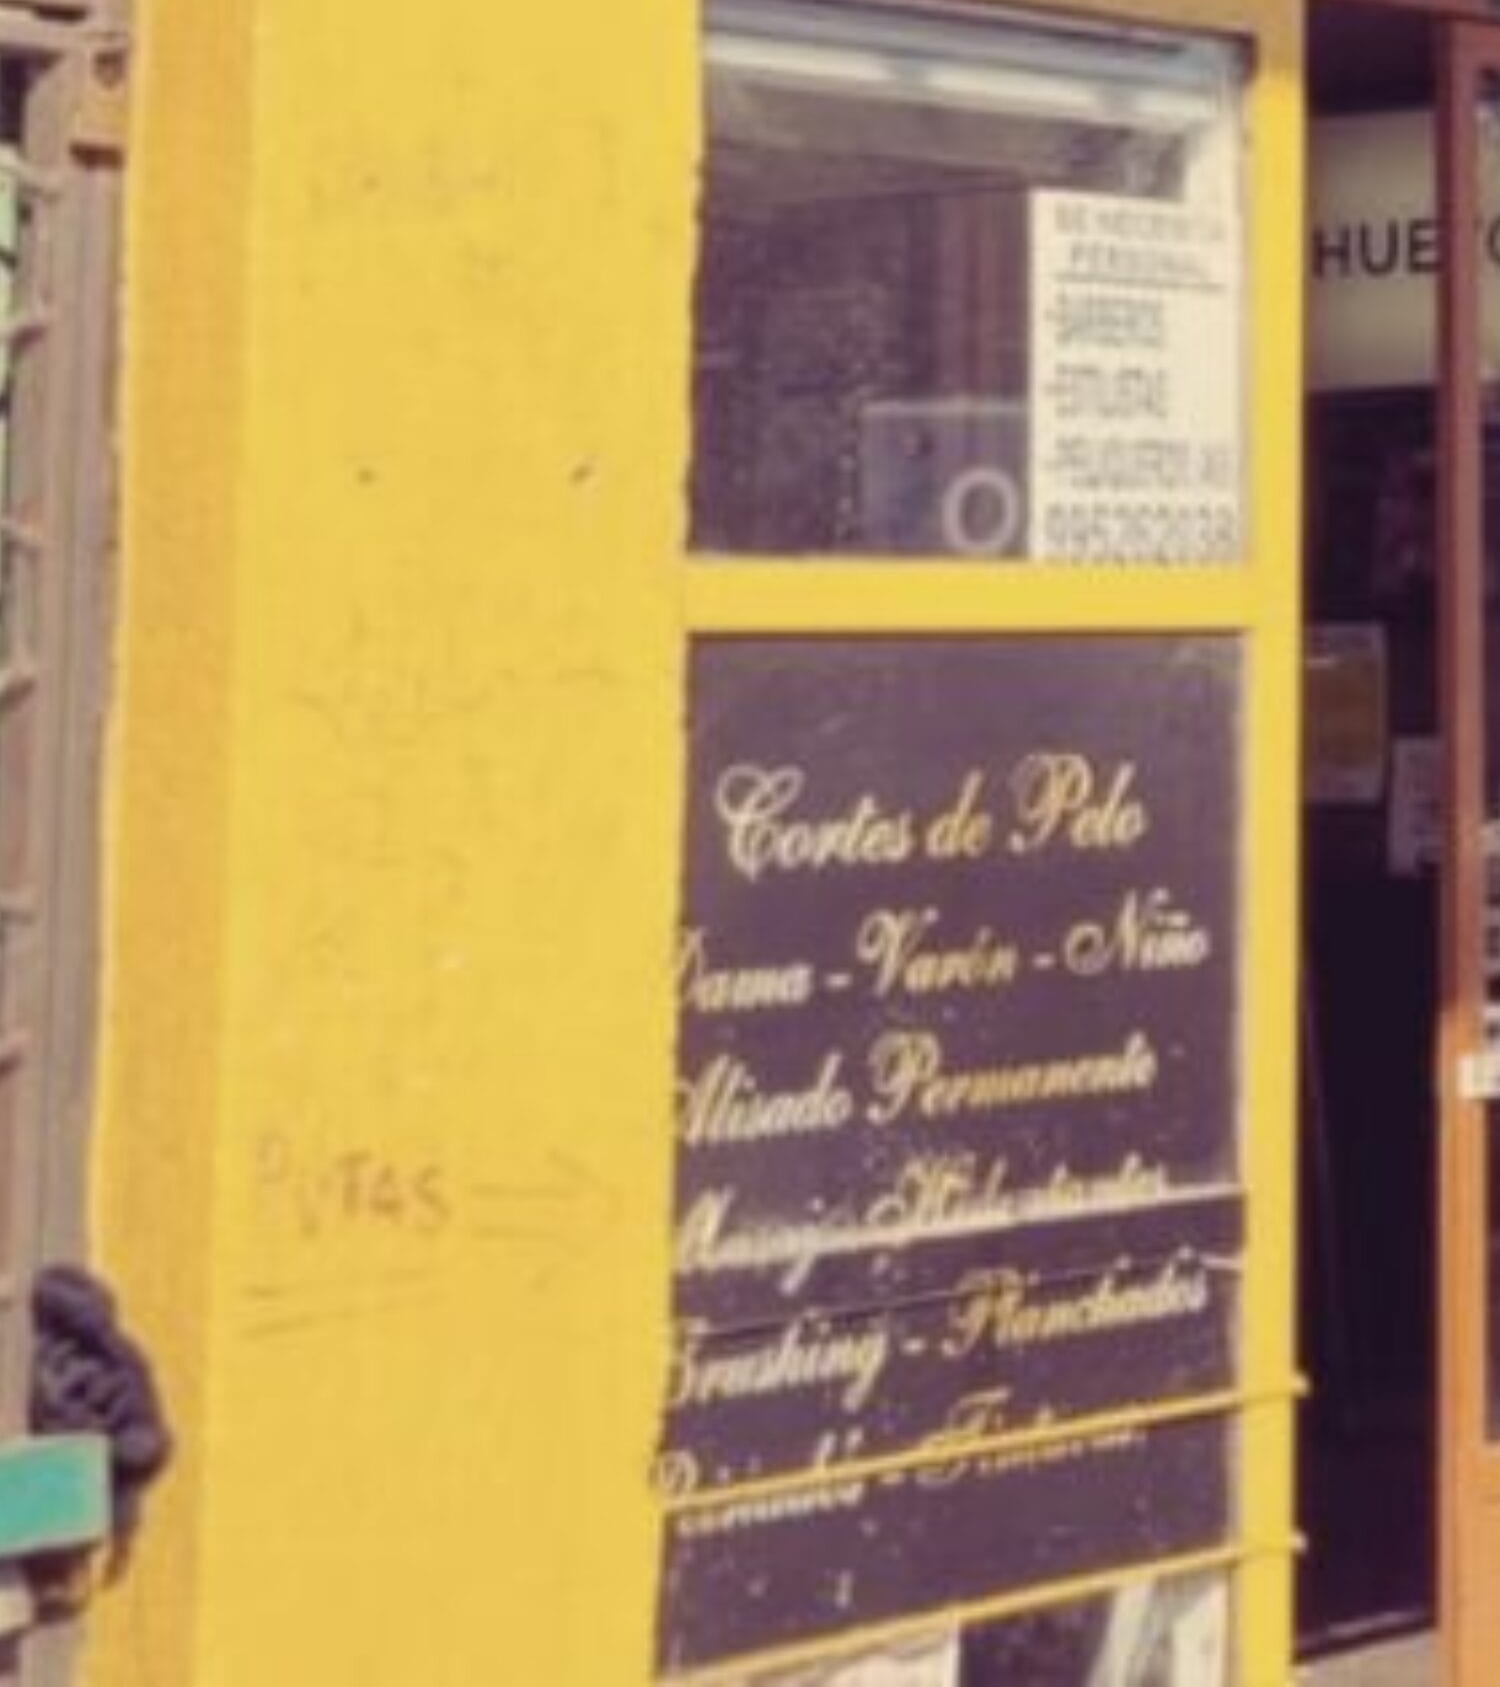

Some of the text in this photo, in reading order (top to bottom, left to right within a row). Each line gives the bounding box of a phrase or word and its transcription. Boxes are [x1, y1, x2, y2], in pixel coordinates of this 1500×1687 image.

[714, 753, 1149, 882] Cortes de Pelo
[1063, 888, 1210, 977] Niño
[867, 1030, 1159, 1125] Permanente
